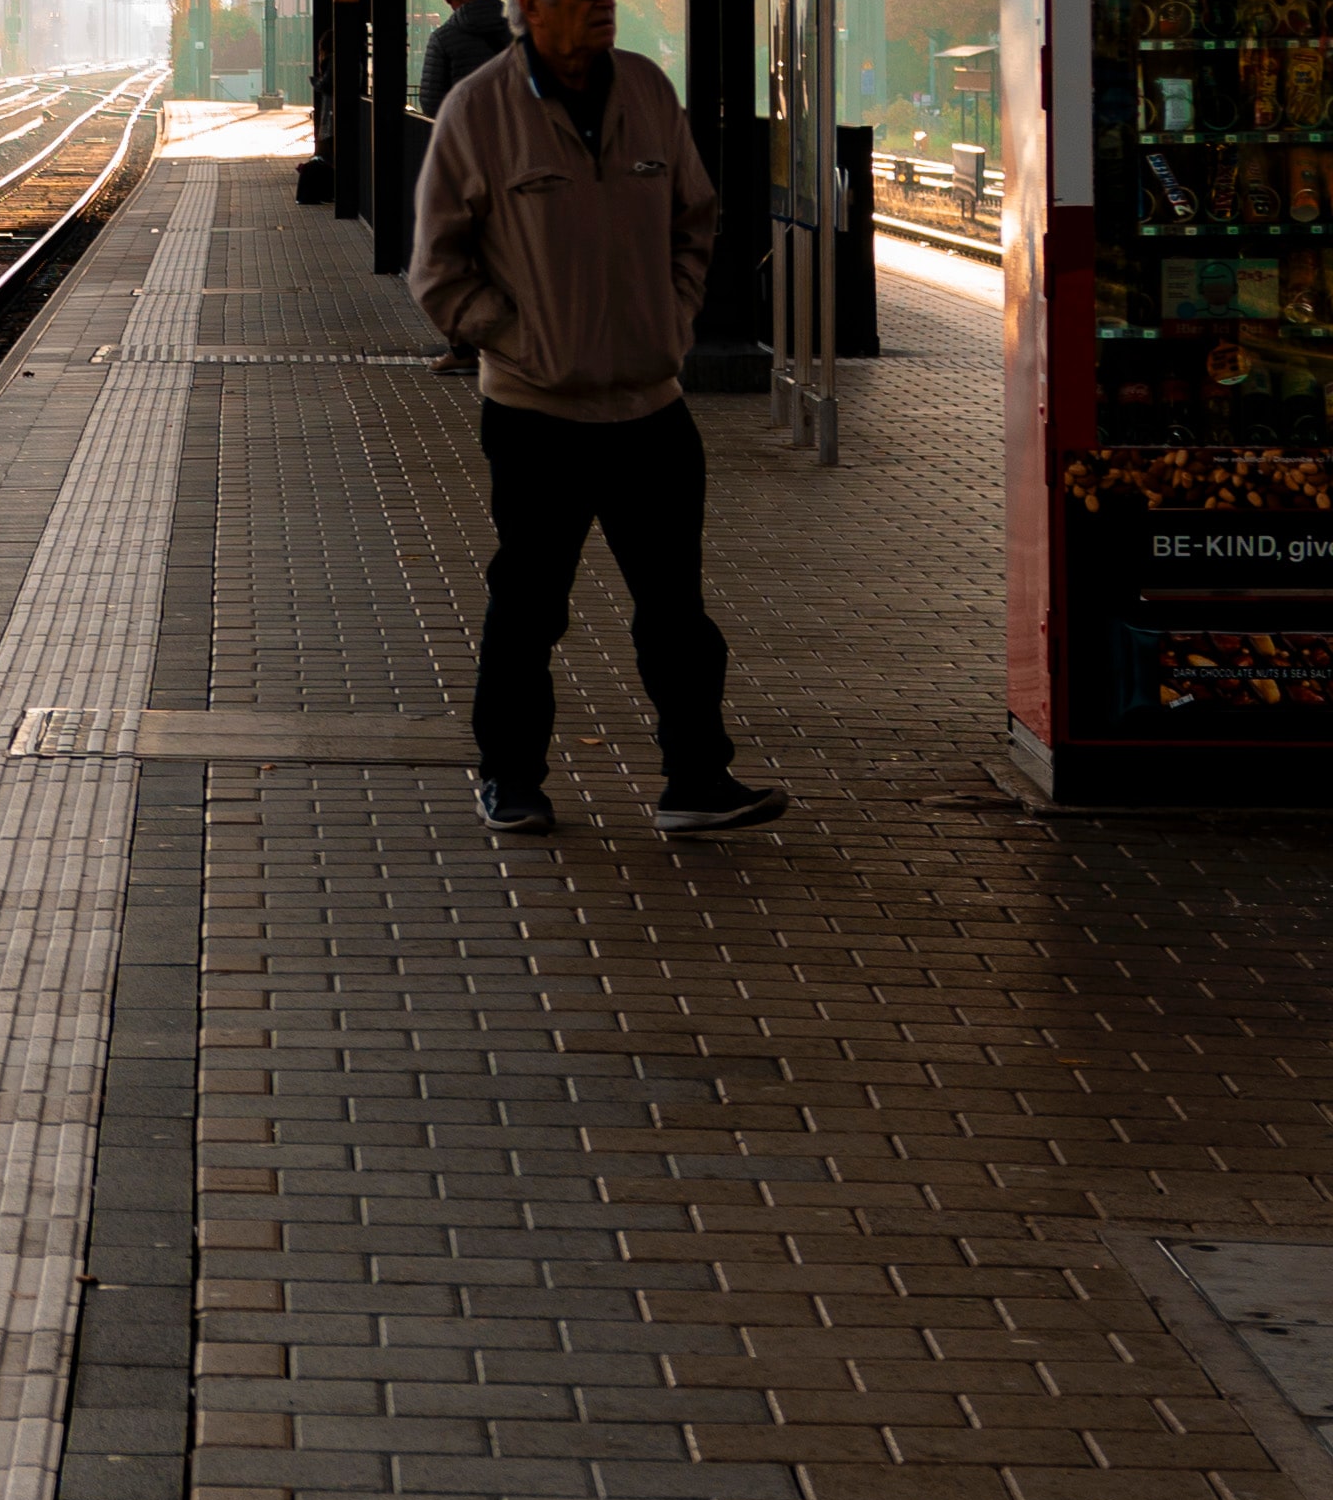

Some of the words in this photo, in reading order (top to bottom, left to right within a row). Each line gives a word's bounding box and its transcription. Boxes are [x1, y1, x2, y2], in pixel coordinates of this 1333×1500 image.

[1152, 534, 1282, 560] BE-KIND,
[1172, 667, 1197, 679] DARK
[1199, 667, 1254, 679] CHOCOLATE
[1255, 667, 1280, 679] NUTS
[1290, 667, 1308, 679] SEA
[1310, 667, 1333, 679] SALT
